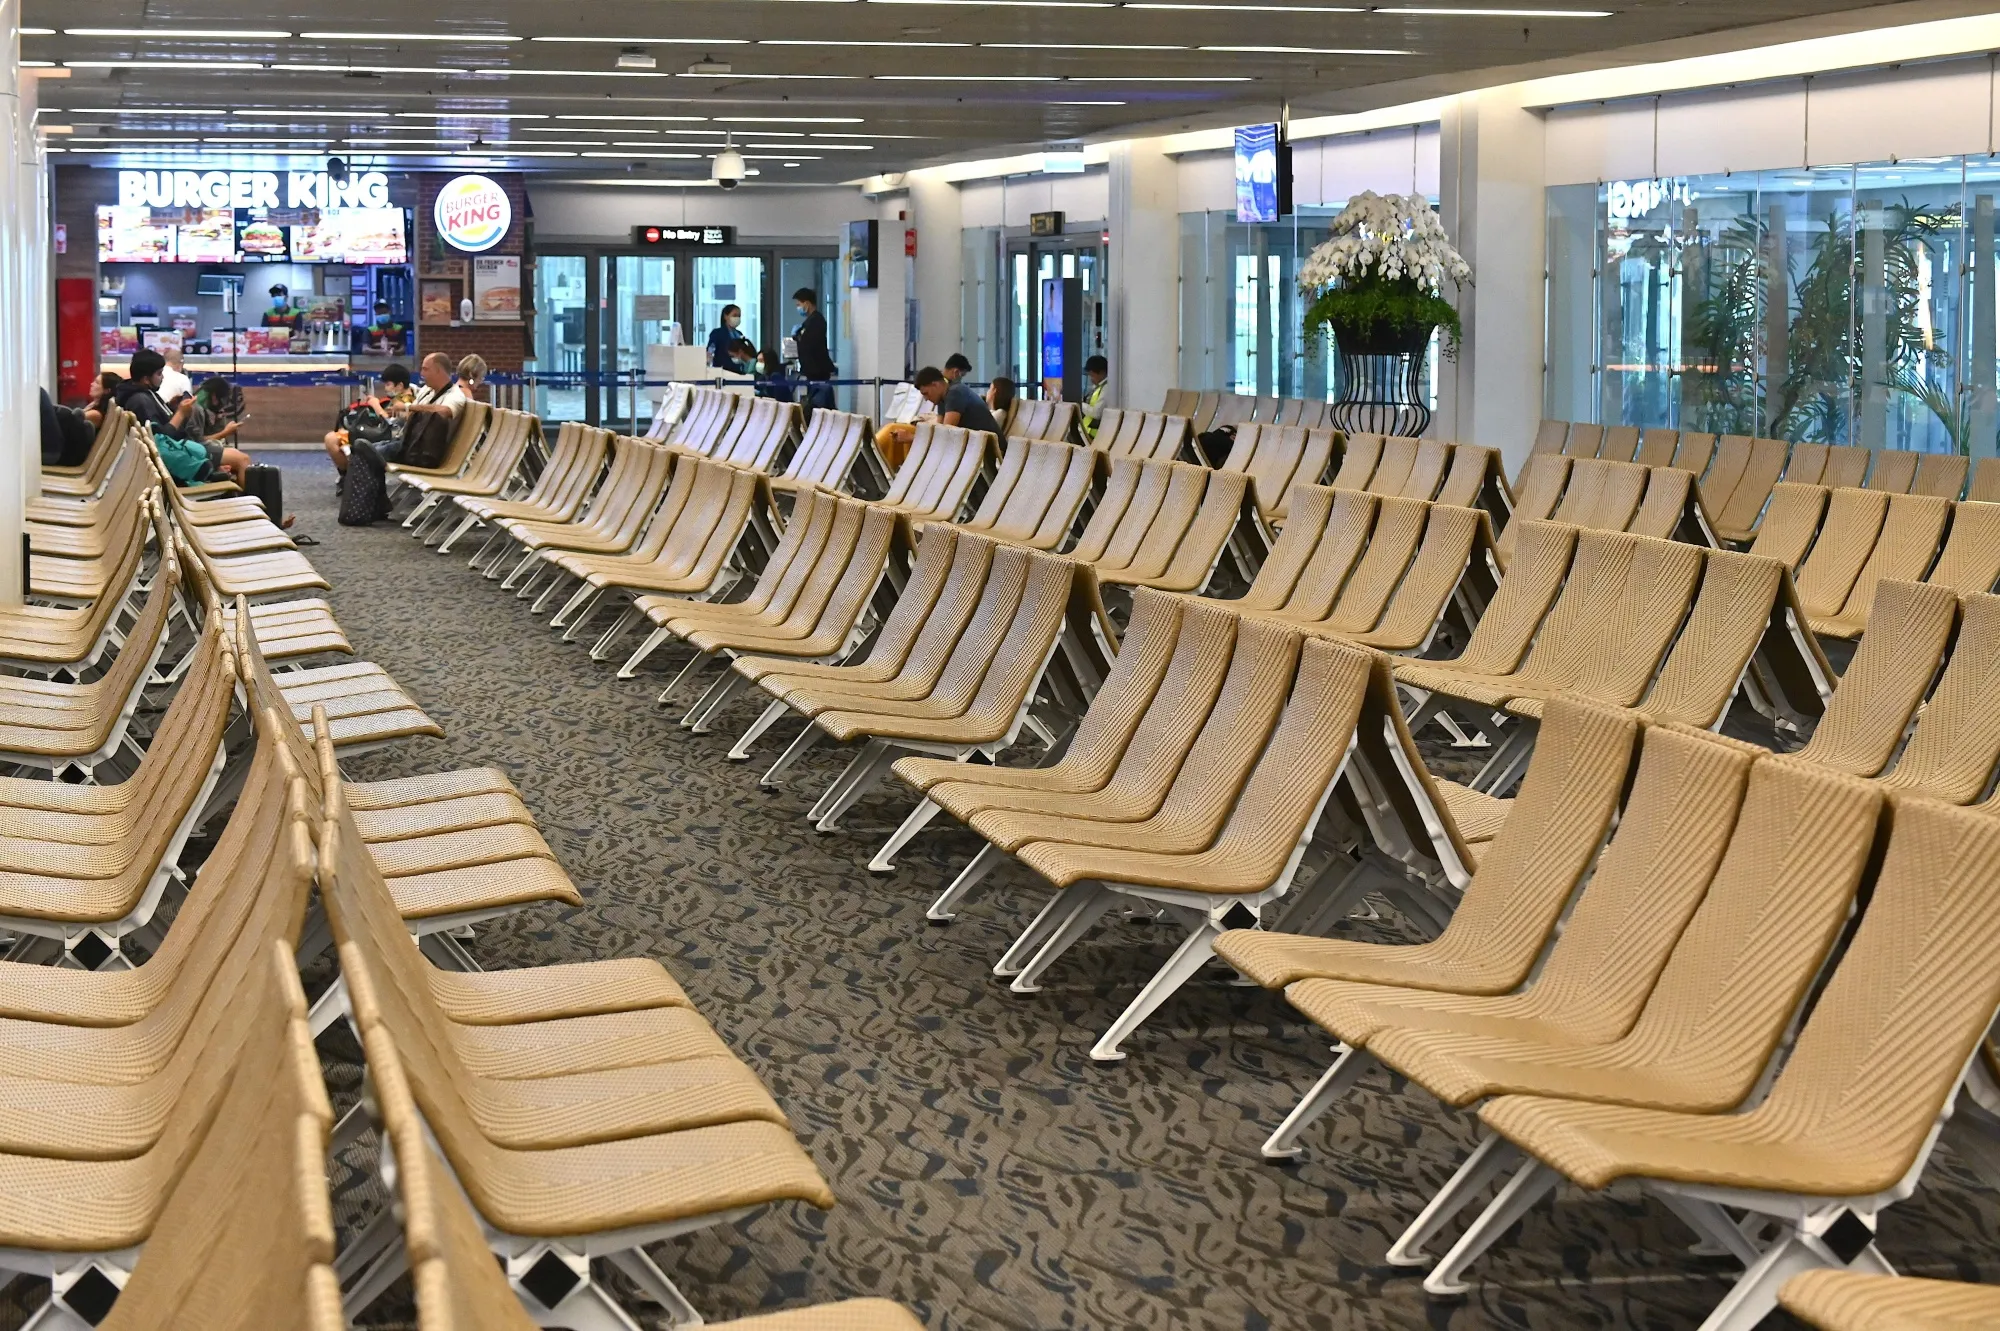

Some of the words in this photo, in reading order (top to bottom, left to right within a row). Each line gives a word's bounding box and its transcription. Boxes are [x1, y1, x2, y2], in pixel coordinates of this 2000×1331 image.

[118, 171, 280, 208] BURGER
[446, 192, 498, 213] BURGER
[448, 204, 500, 231] KING
[662, 229, 676, 239] No
[677, 229, 700, 241] Entry
